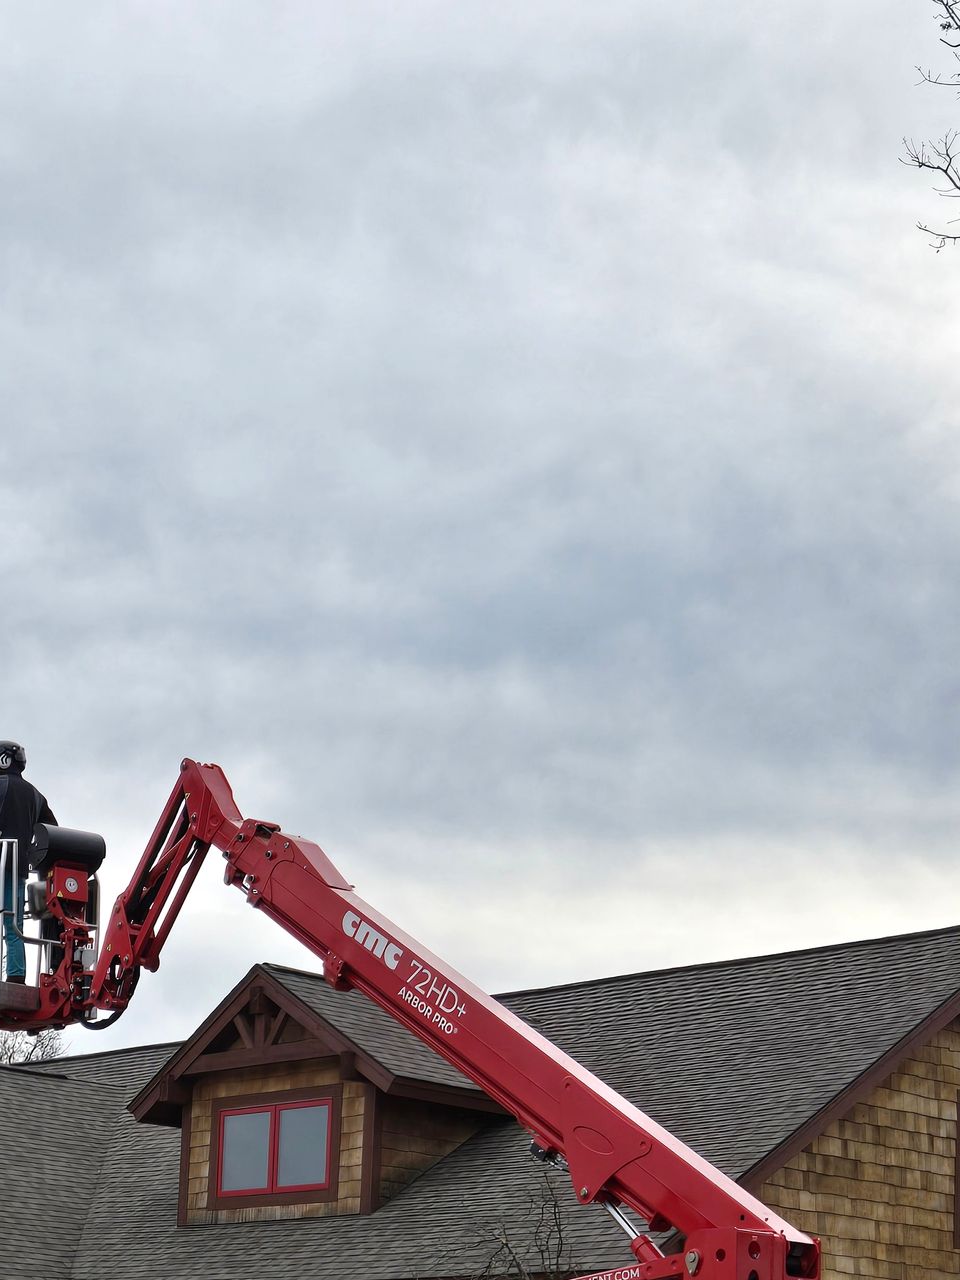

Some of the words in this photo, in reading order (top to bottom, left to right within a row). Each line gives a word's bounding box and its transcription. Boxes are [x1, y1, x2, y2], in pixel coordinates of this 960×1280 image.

[342, 910, 403, 970] cmc
[406, 960, 466, 1017] 72HD+
[398, 986, 433, 1019] ARBOR
